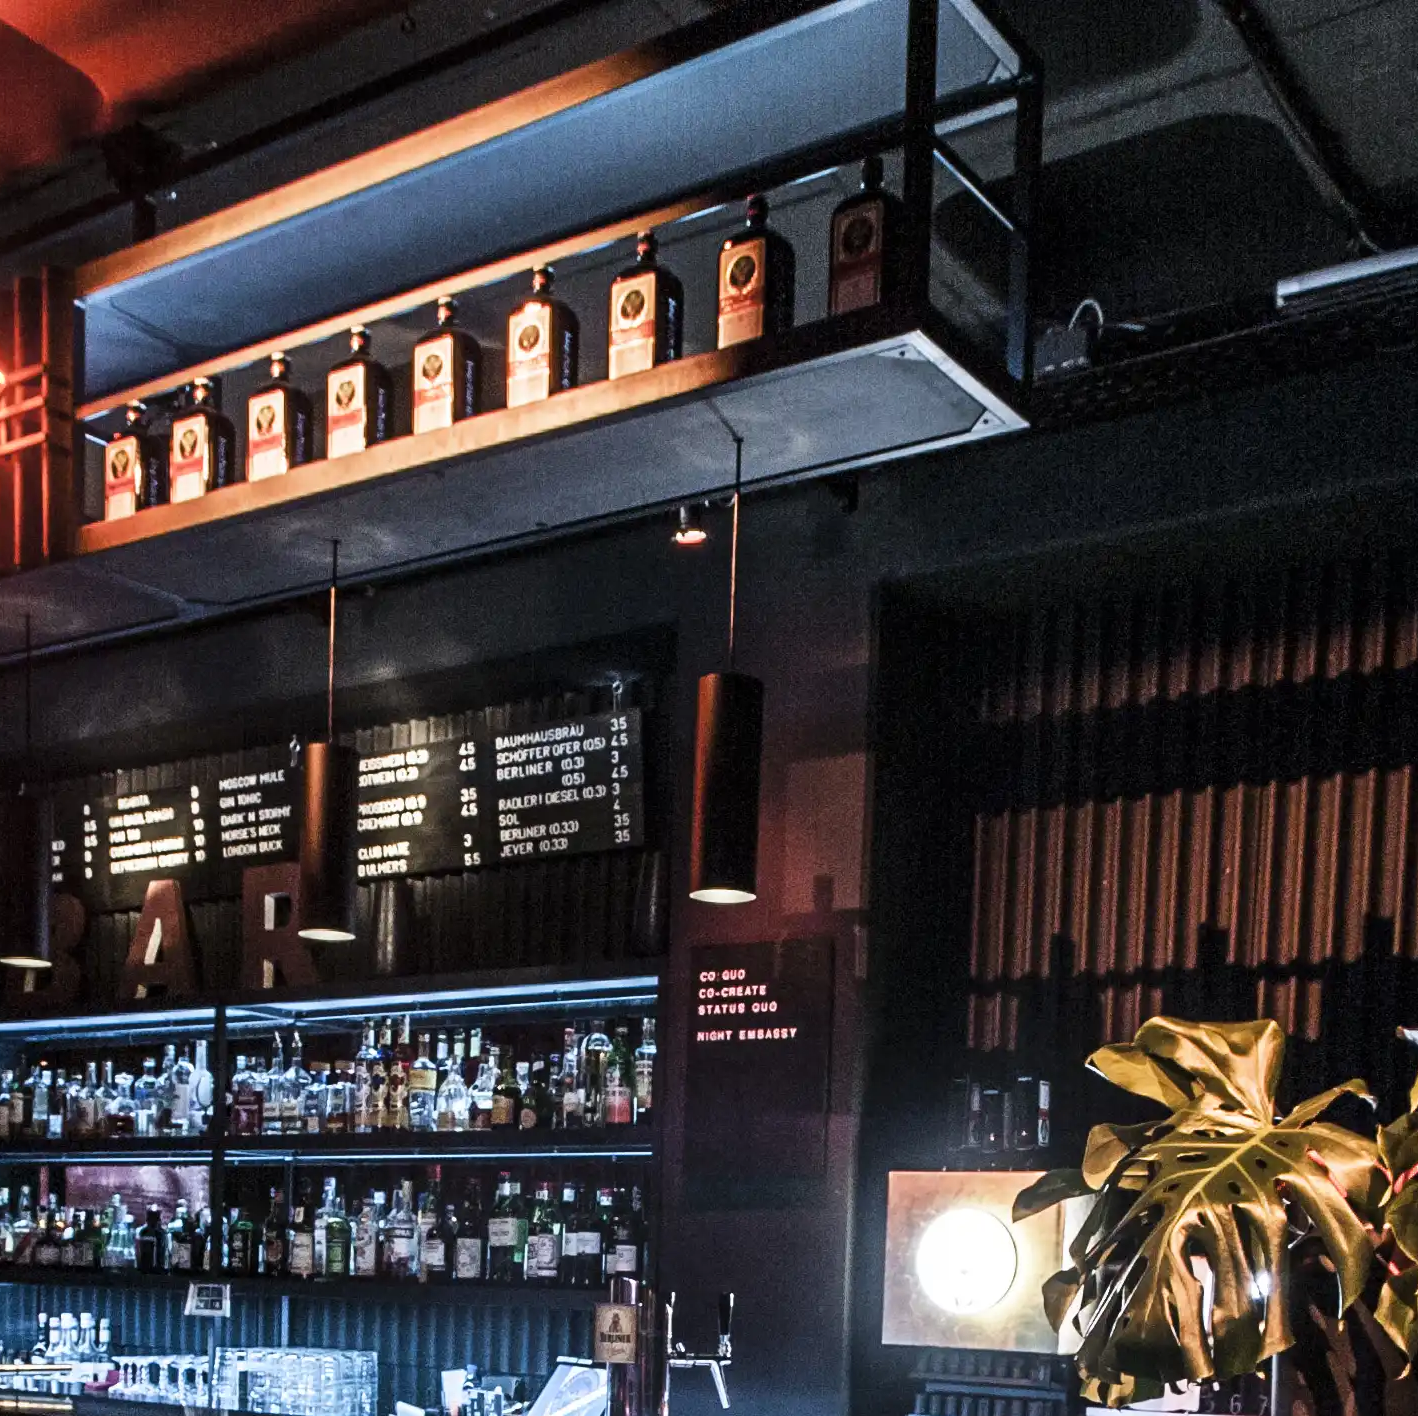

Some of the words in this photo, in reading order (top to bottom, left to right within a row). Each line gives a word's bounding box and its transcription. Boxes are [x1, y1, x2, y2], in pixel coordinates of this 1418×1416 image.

[495, 723, 585, 750] BAUMHAUSBRÄU
[496, 760, 553, 782] BERLINER
[611, 751, 620, 764] 3
[219, 775, 257, 792] MOSCOW
[259, 769, 285, 784] MULE
[237, 792, 262, 806] TONIC
[544, 788, 580, 805] DIESEL
[612, 782, 621, 796] 3
[259, 805, 291, 820] STORMY
[498, 813, 520, 827] SOL
[613, 798, 621, 811] 4
[259, 823, 281, 837] NECK
[499, 824, 547, 842] BERLINER
[223, 844, 257, 858] LONDON
[357, 845, 382, 861] CLUB
[464, 833, 473, 847] 3
[500, 841, 534, 858] JEVER
[698, 984, 767, 999] CO-CREATE
[698, 1002, 746, 1016] STATUS
[751, 1001, 778, 1014] QUO
[696, 1030, 732, 1042] NIGHT
[738, 1027, 798, 1041] EMBASSY
[1229, 1393, 1243, 1415] 6
